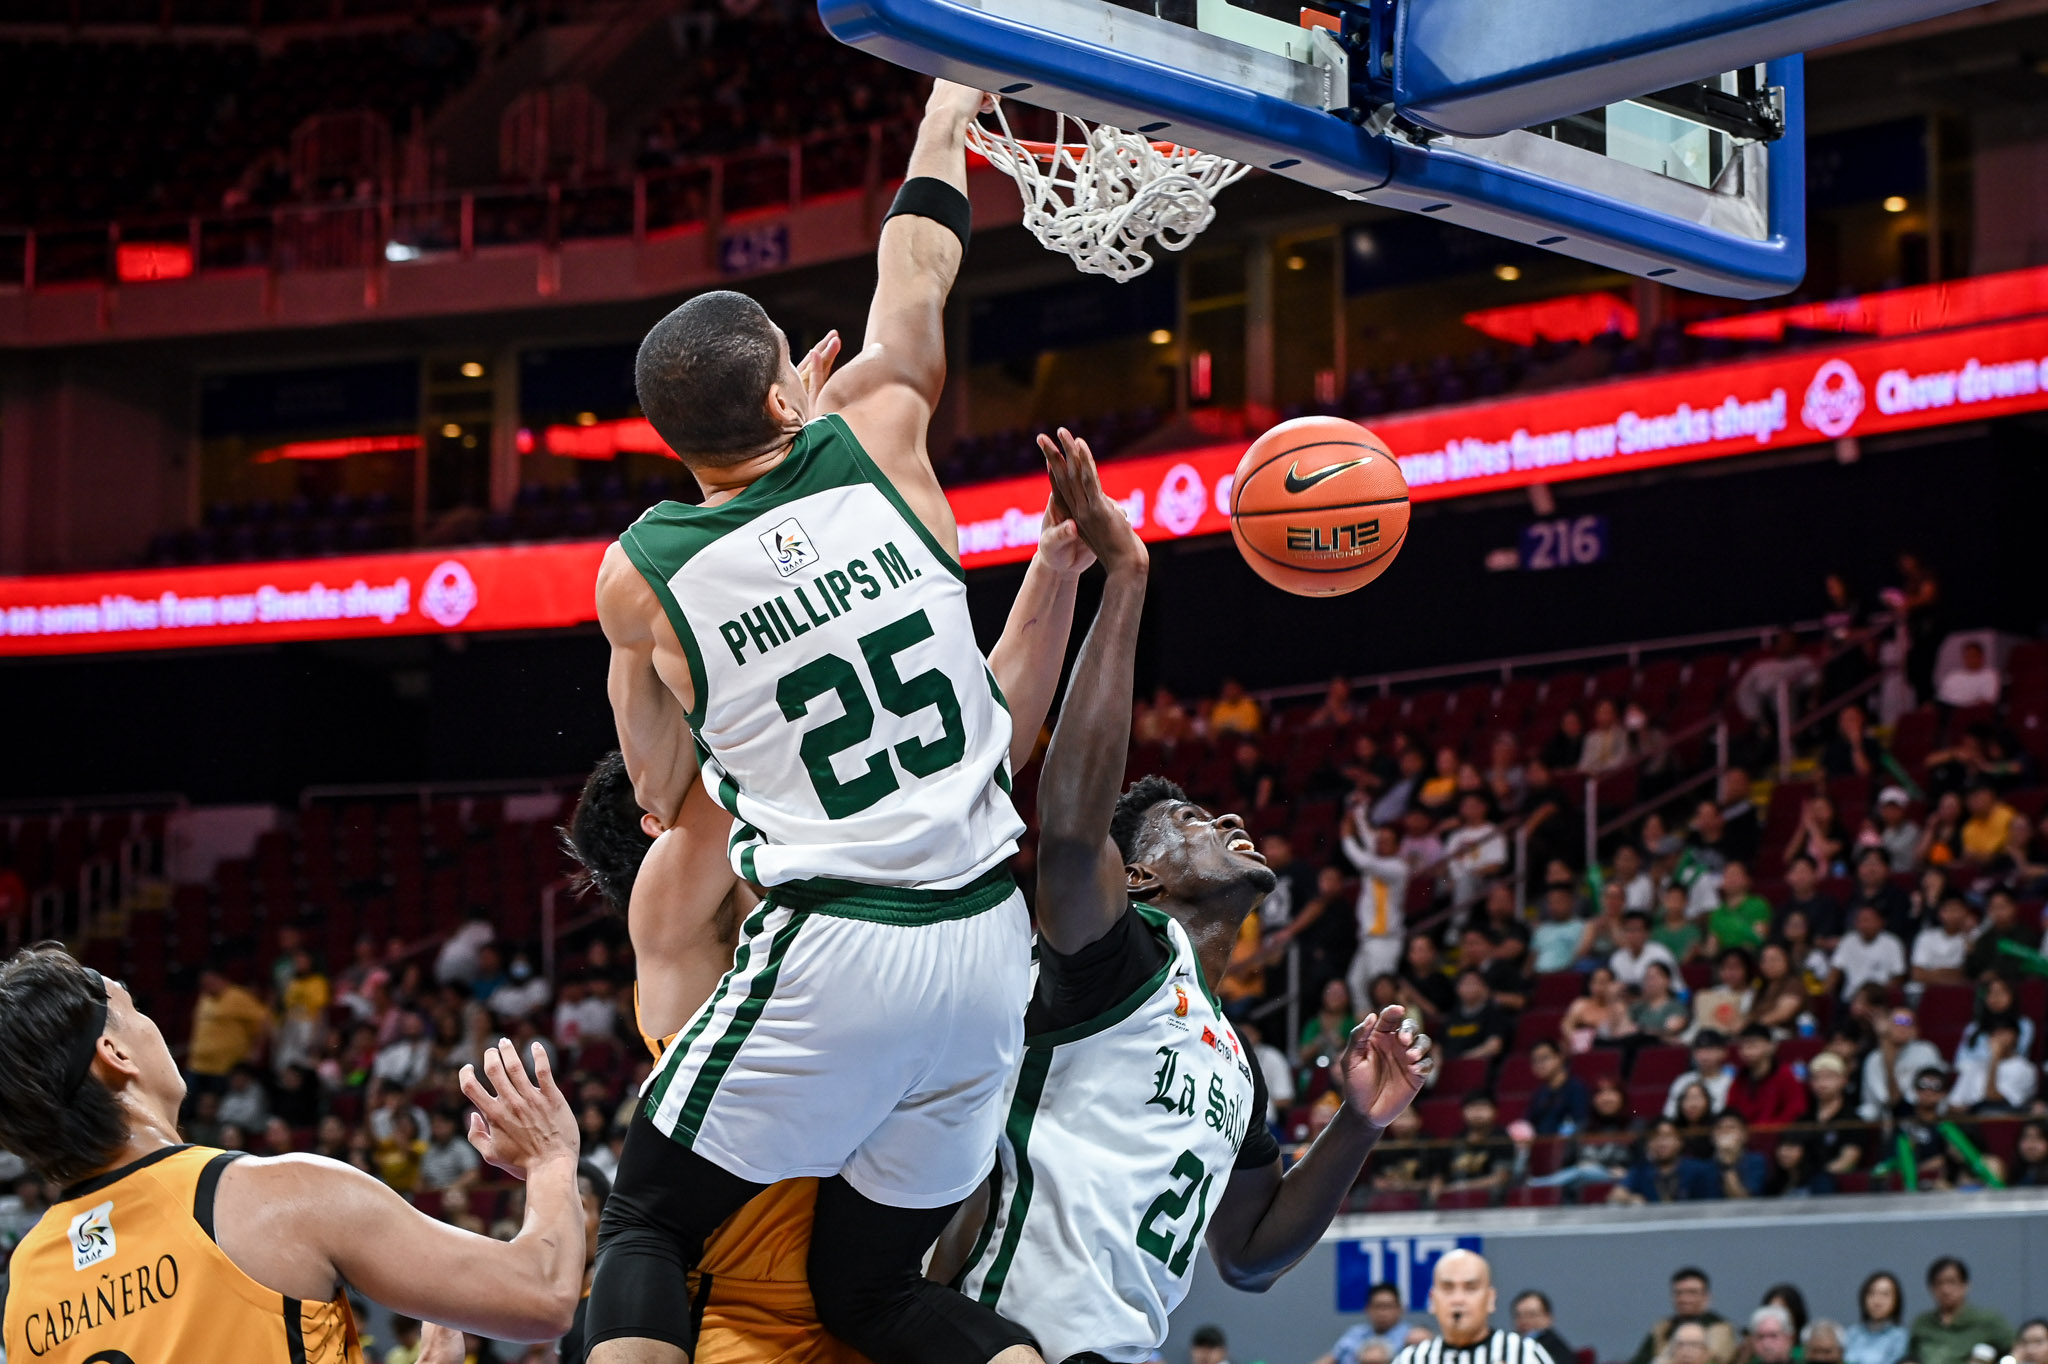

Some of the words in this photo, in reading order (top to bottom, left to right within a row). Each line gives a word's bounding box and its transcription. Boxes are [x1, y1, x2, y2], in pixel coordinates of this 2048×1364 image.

[1398, 450, 1445, 487] ome
[1511, 428, 1573, 471] from
[1616, 411, 1711, 455] Snacks
[1711, 388, 1787, 443] shop!
[783, 558, 804, 573] UAAP
[1287, 518, 1380, 552] ELITE
[1528, 515, 1600, 570] 216
[718, 559, 882, 667] PHILLIPS
[872, 541, 922, 590] M.
[775, 608, 967, 821] 25
[1145, 1045, 1196, 1118] La
[1136, 1149, 1214, 1279] 21
[77, 1249, 102, 1267] UAAP
[25, 1254, 179, 1358] CABAÑERO
